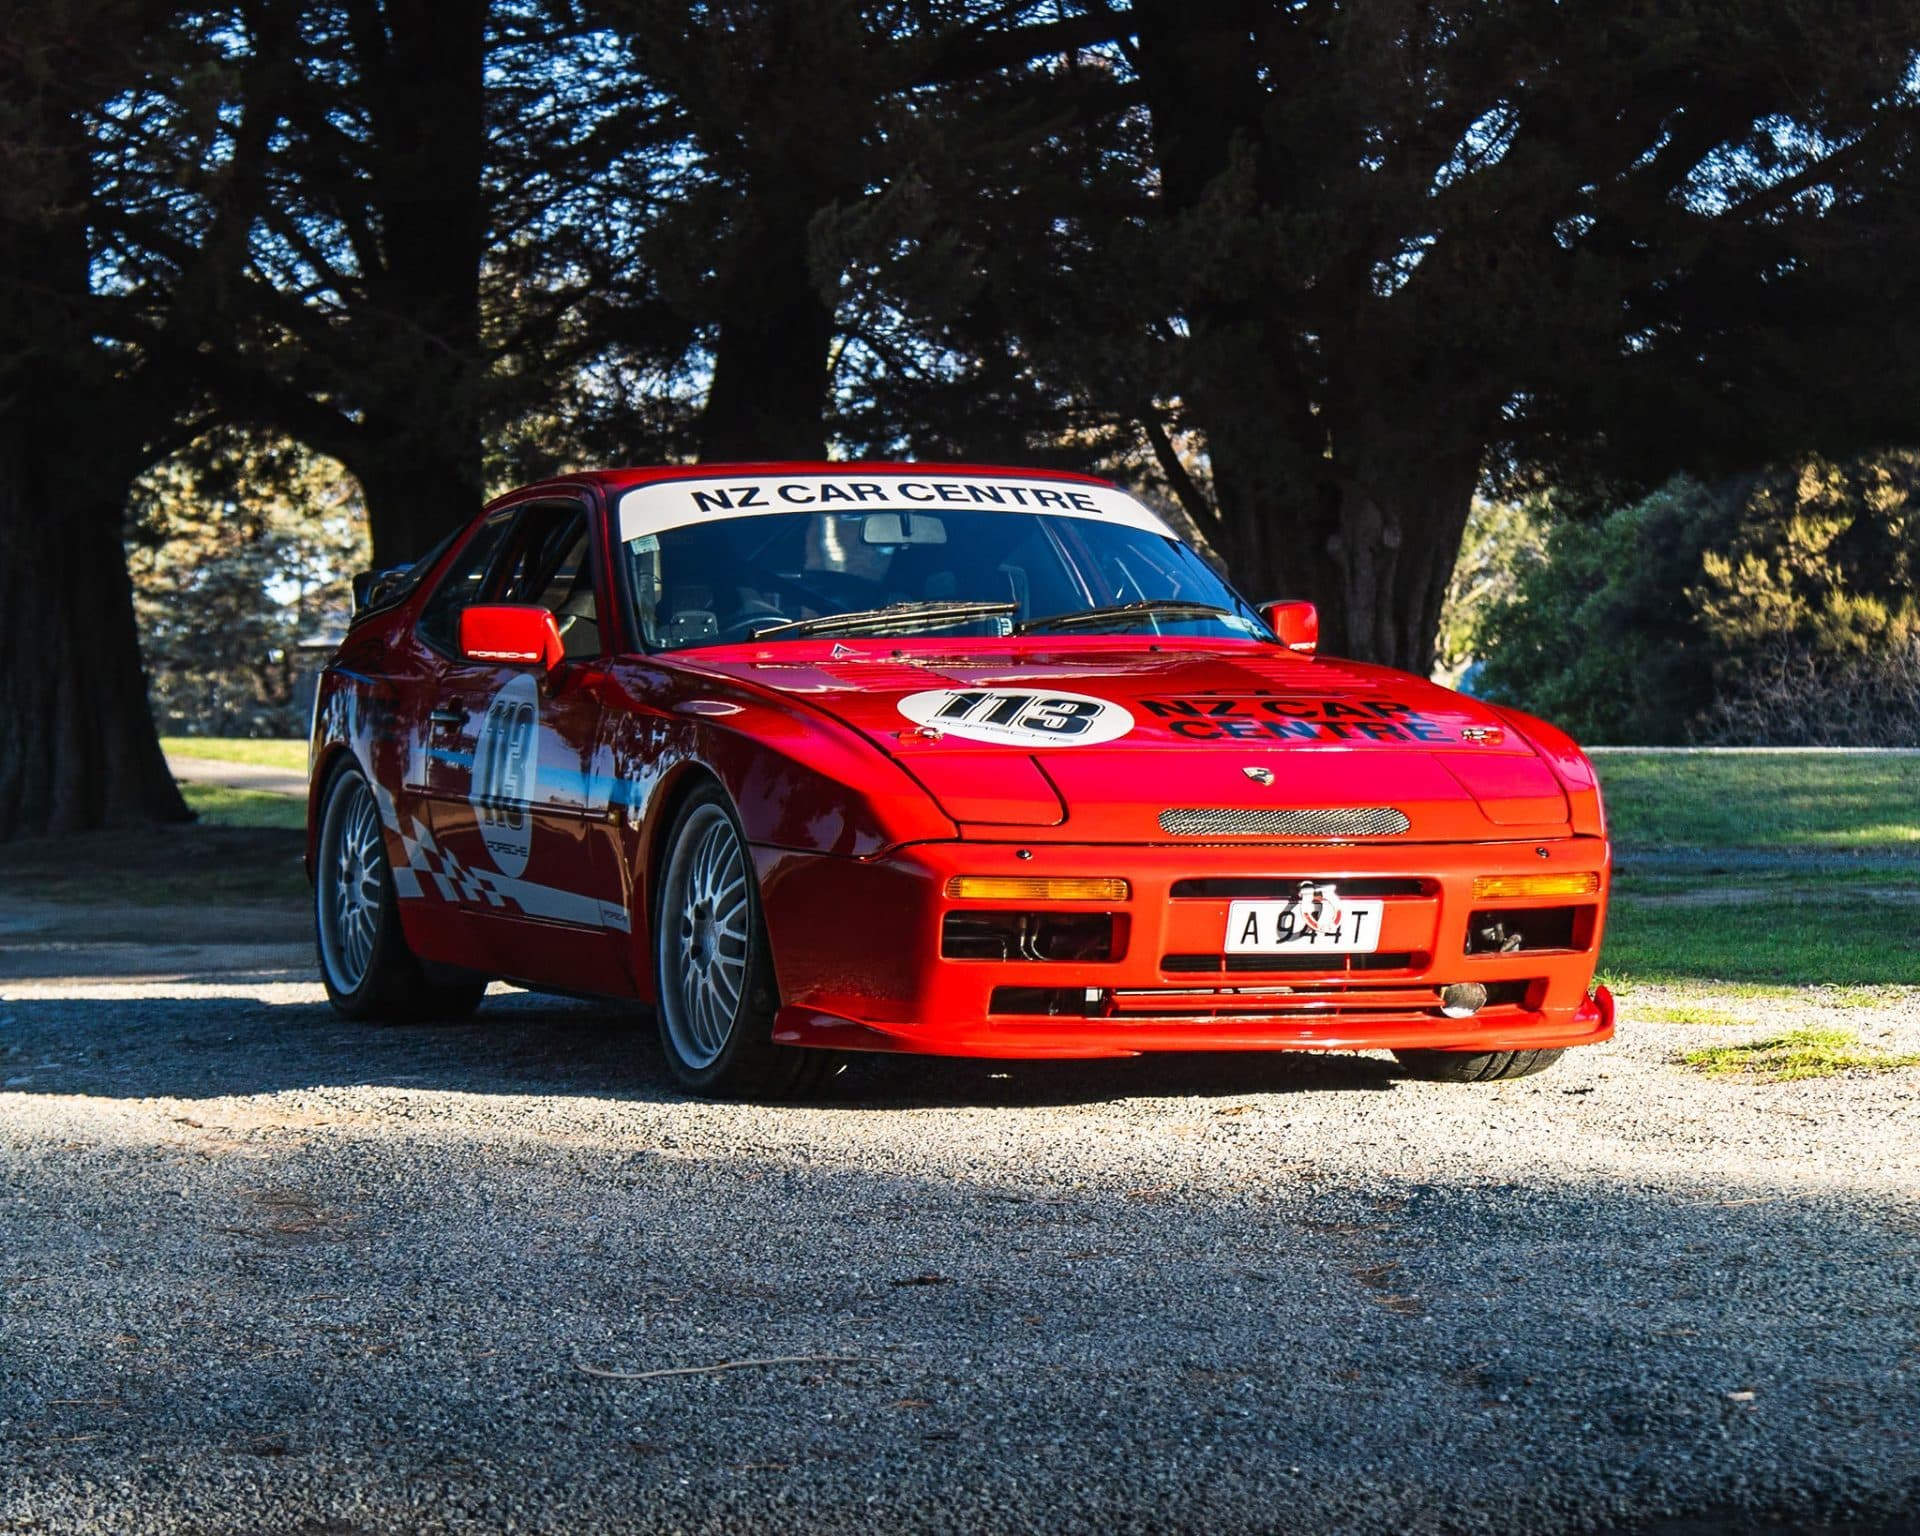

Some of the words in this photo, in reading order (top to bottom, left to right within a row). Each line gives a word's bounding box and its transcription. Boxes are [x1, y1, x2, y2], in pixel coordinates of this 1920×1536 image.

[690, 486, 769, 512] NZ
[777, 483, 889, 504] CAR
[897, 483, 1103, 514] CENTRE
[943, 691, 1106, 735] 113
[1140, 699, 1253, 717] NZ
[1260, 700, 1423, 722] CAR
[1168, 720, 1456, 743] CENTRE
